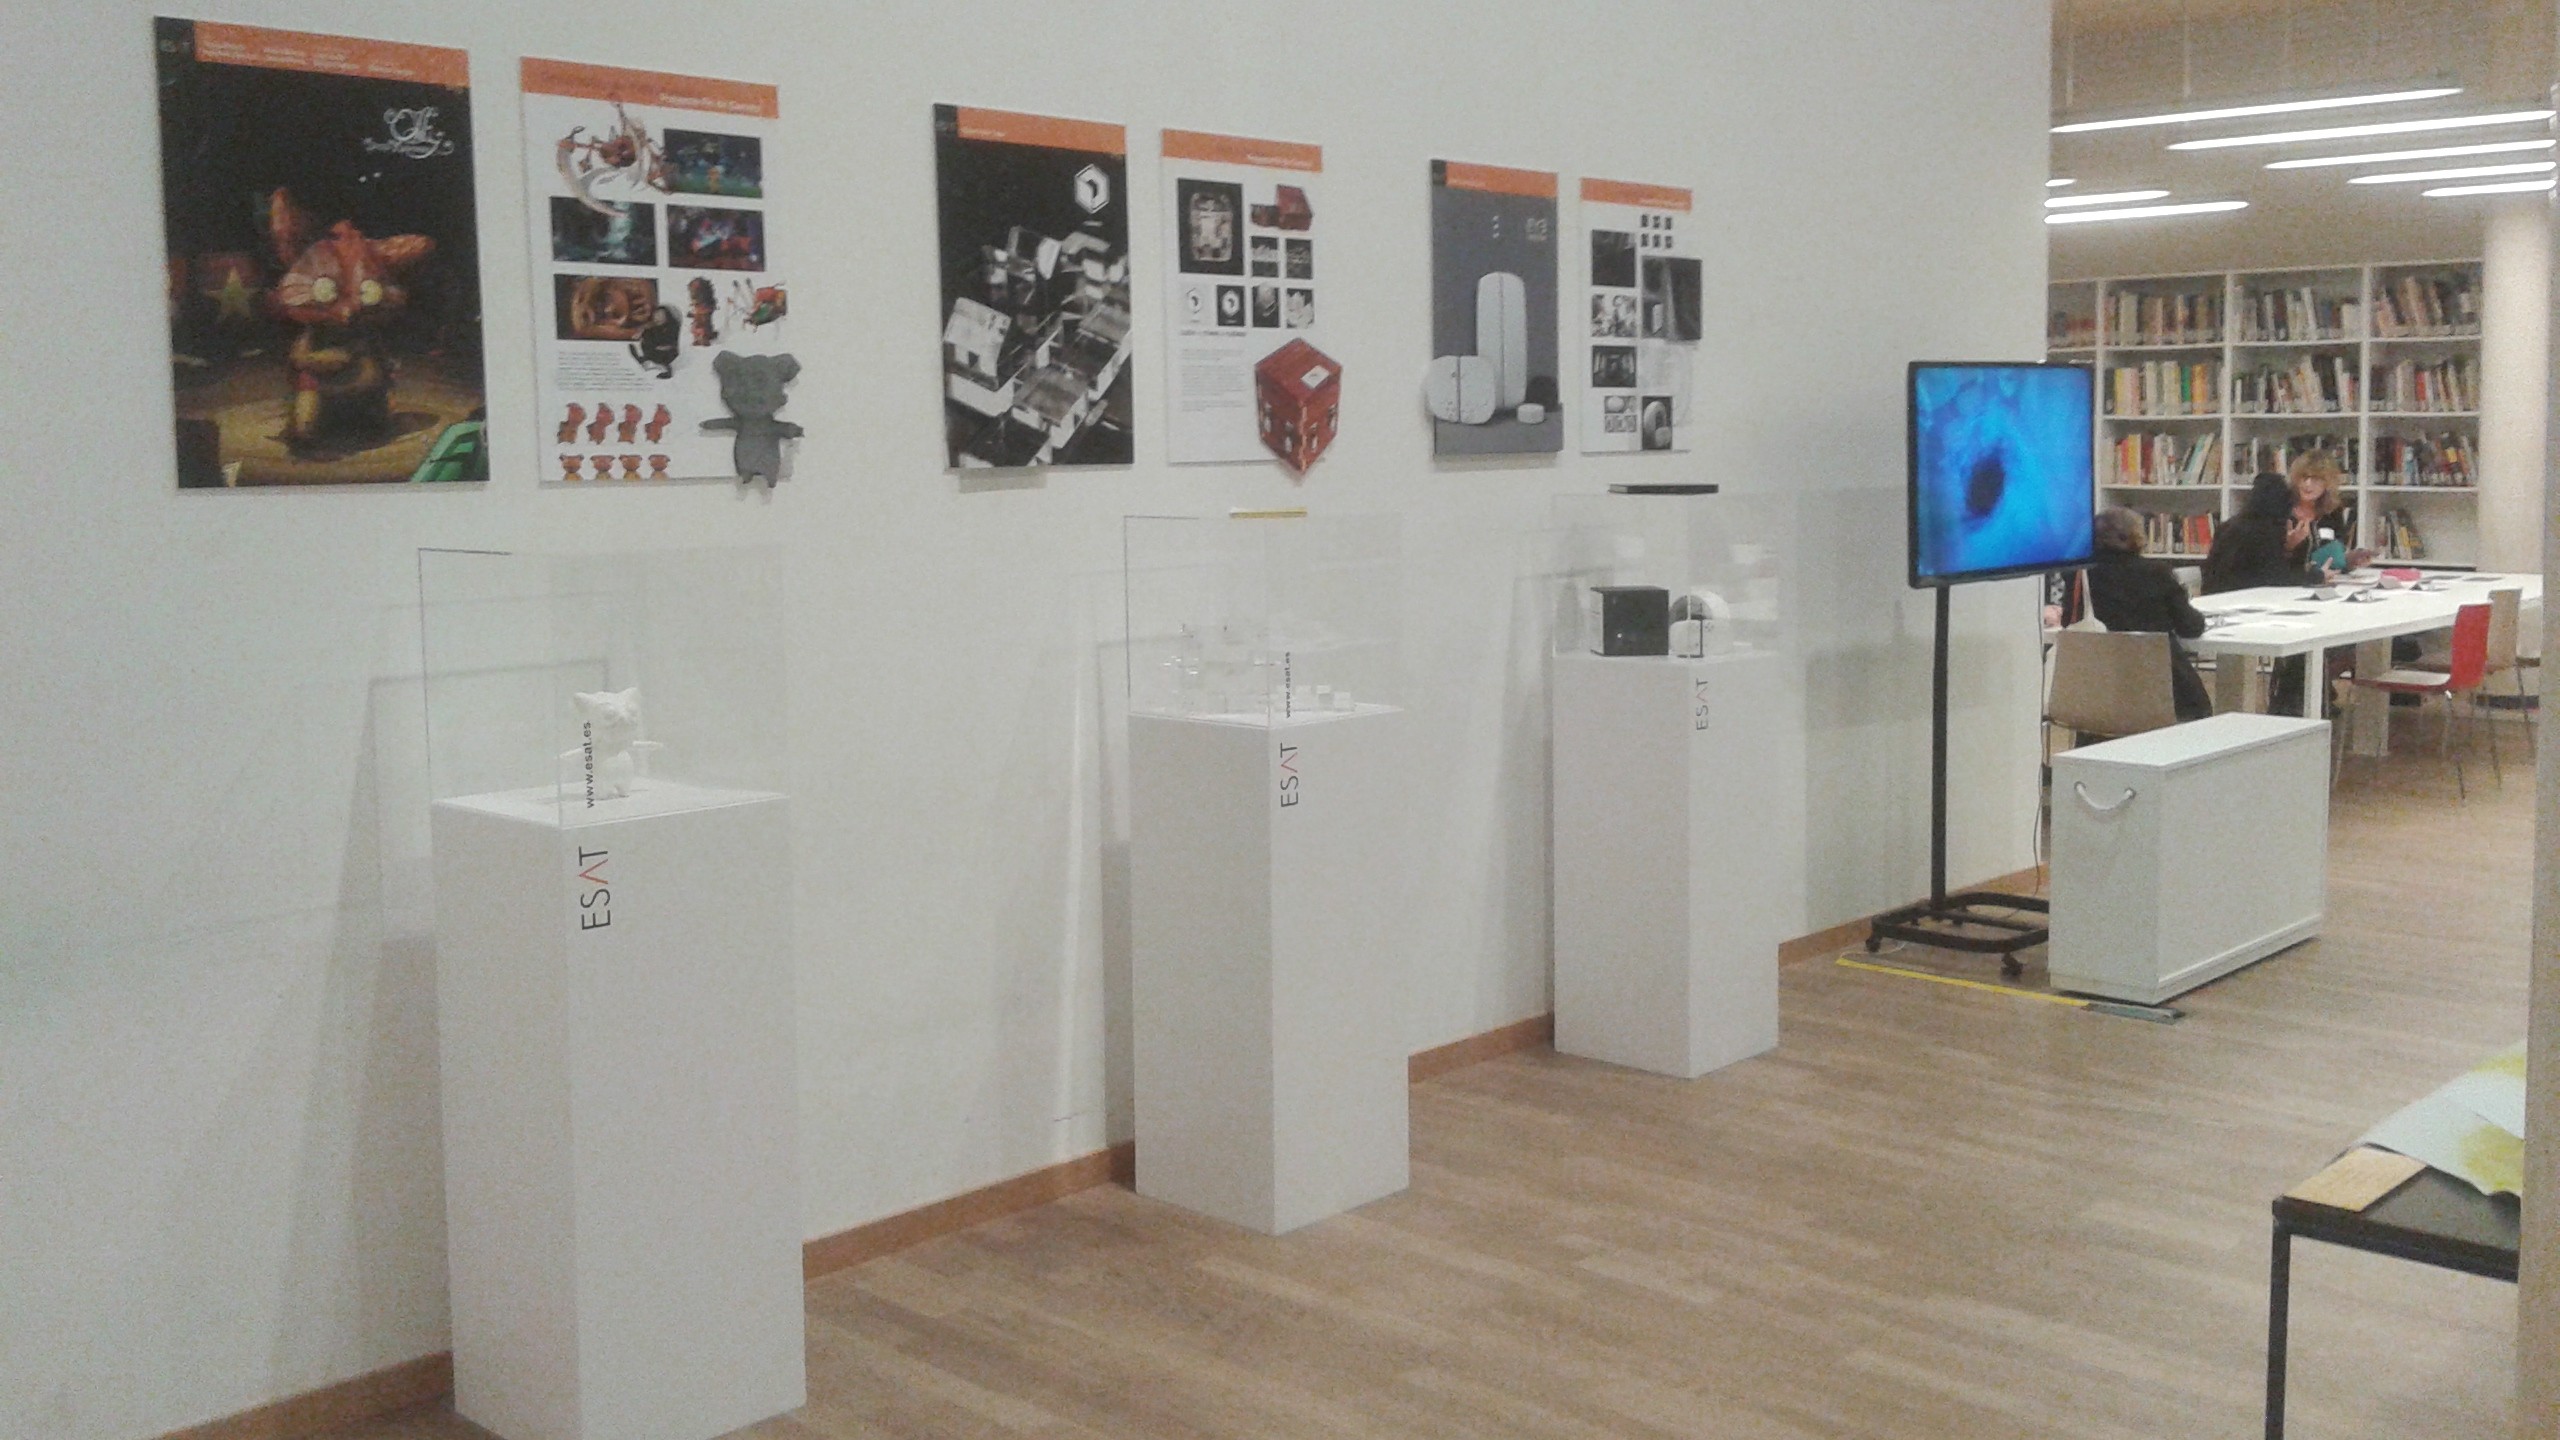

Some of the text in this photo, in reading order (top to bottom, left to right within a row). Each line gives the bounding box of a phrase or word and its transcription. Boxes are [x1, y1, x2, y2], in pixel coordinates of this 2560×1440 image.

[1696, 678, 1710, 731] ESAT
[582, 720, 595, 808] www.esat.es
[1280, 742, 1299, 808] ESAT
[579, 845, 611, 931] ESAT
